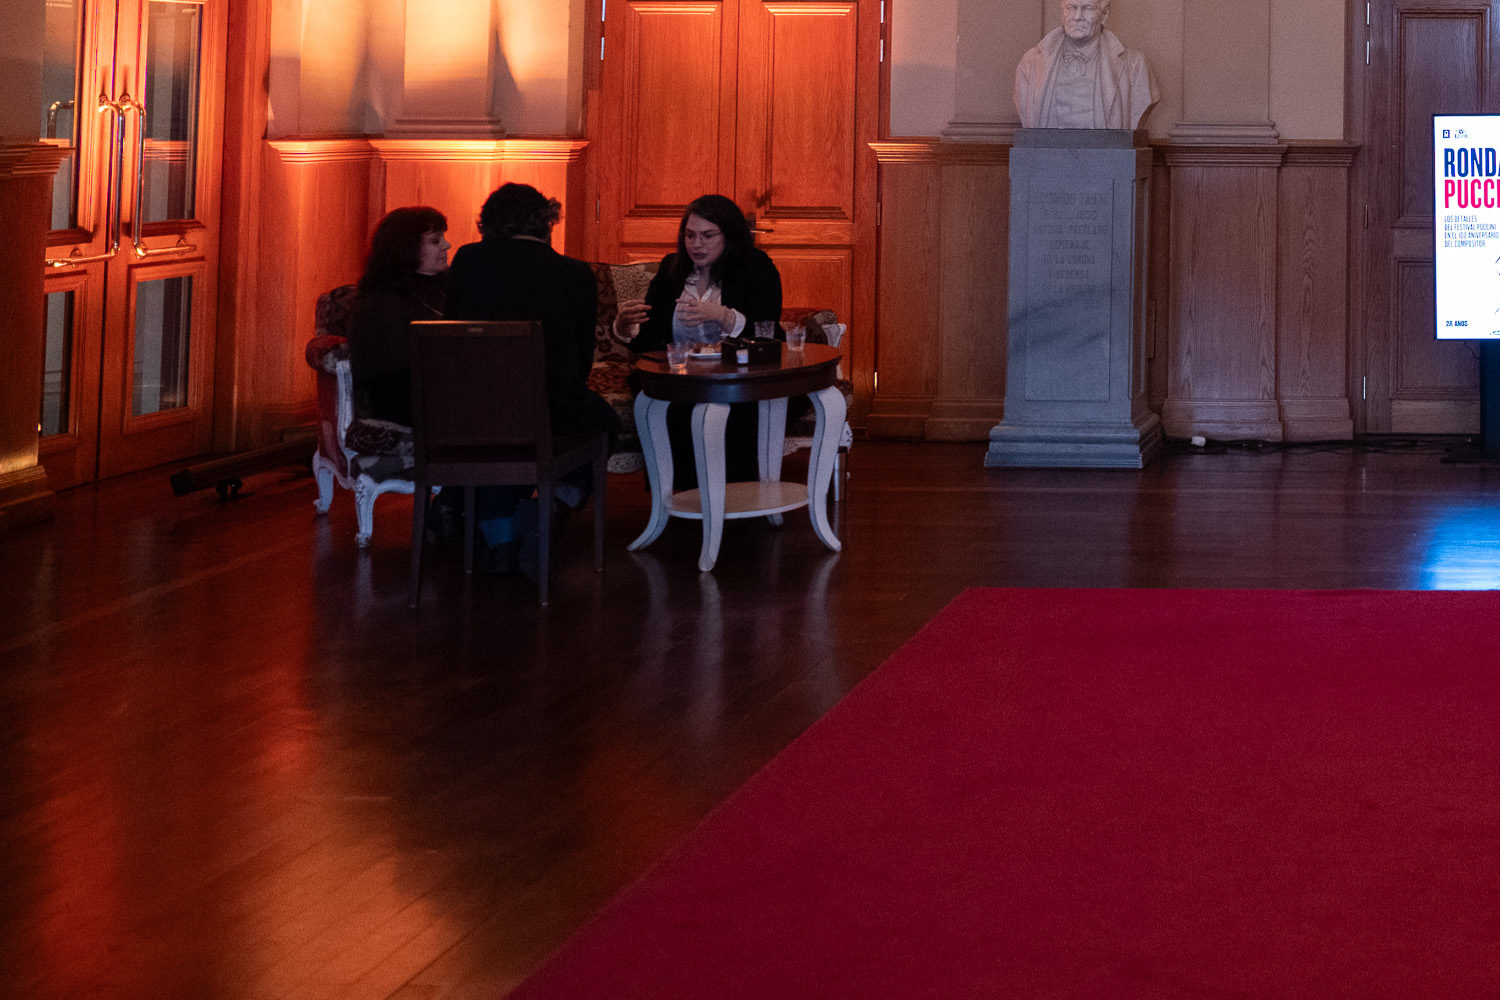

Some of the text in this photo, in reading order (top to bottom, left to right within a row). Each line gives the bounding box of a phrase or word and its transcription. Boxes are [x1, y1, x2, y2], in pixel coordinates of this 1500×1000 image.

[1444, 215, 1478, 223] LOS DETALLES
[1444, 223, 1497, 231] DEL FESTIVAL PUCCINI
